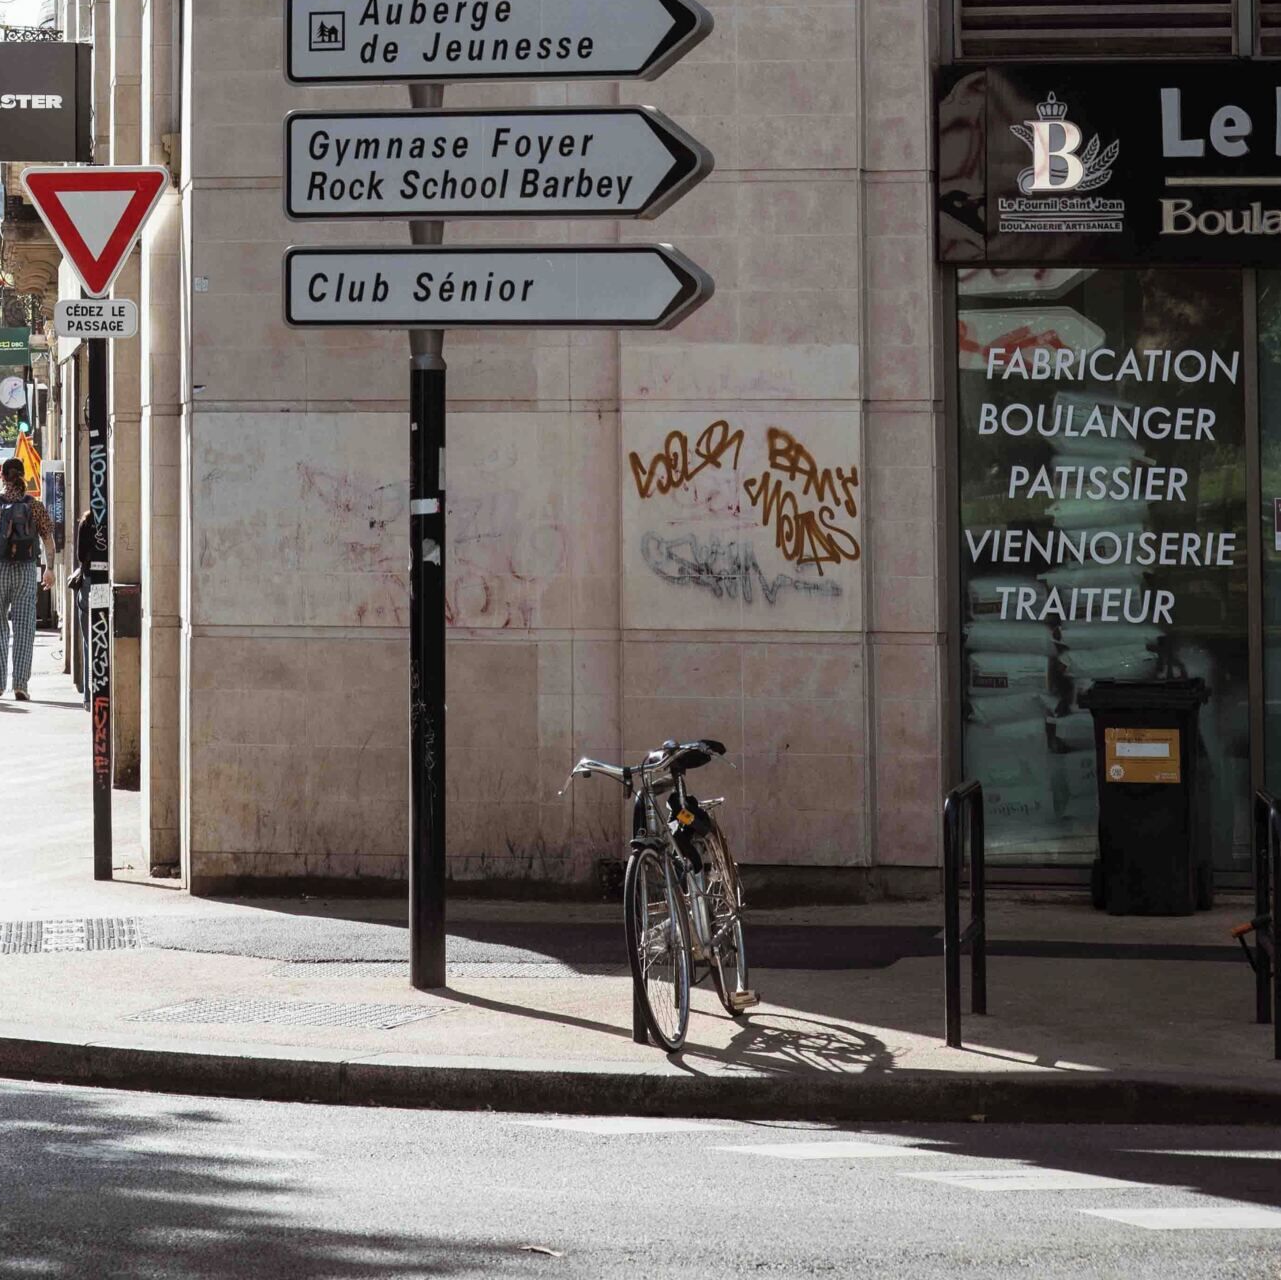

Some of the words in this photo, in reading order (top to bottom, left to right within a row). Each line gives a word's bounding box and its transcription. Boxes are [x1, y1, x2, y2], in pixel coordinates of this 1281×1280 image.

[360, 35, 398, 63] de
[423, 32, 595, 63] Jeunesse
[1160, 87, 1253, 158] Le
[308, 130, 469, 167] Gymnase
[491, 128, 594, 163] Foyer
[307, 170, 385, 200] Rock
[399, 168, 508, 200] School
[519, 168, 633, 204] Barbey
[1000, 199, 1015, 210] Le
[1017, 199, 1058, 210] Fournil
[1061, 199, 1092, 210] Saint
[1094, 199, 1123, 210] Jean
[1000, 222, 1062, 231] BOULANGERIE
[1065, 222, 1121, 231] ARTISANALE
[307, 272, 390, 303] Club
[413, 271, 535, 303] Sénior
[65, 304, 104, 317] CÉDEZ
[111, 306, 126, 317] LE
[67, 320, 124, 332] PASSAGE
[986, 347, 1240, 385] FABRICATION
[978, 403, 1216, 441] BOULANGER
[1008, 464, 1188, 502] PATISSIER
[964, 529, 1236, 567] VIENNOISERIE
[995, 586, 1176, 625] TRAITEUR
